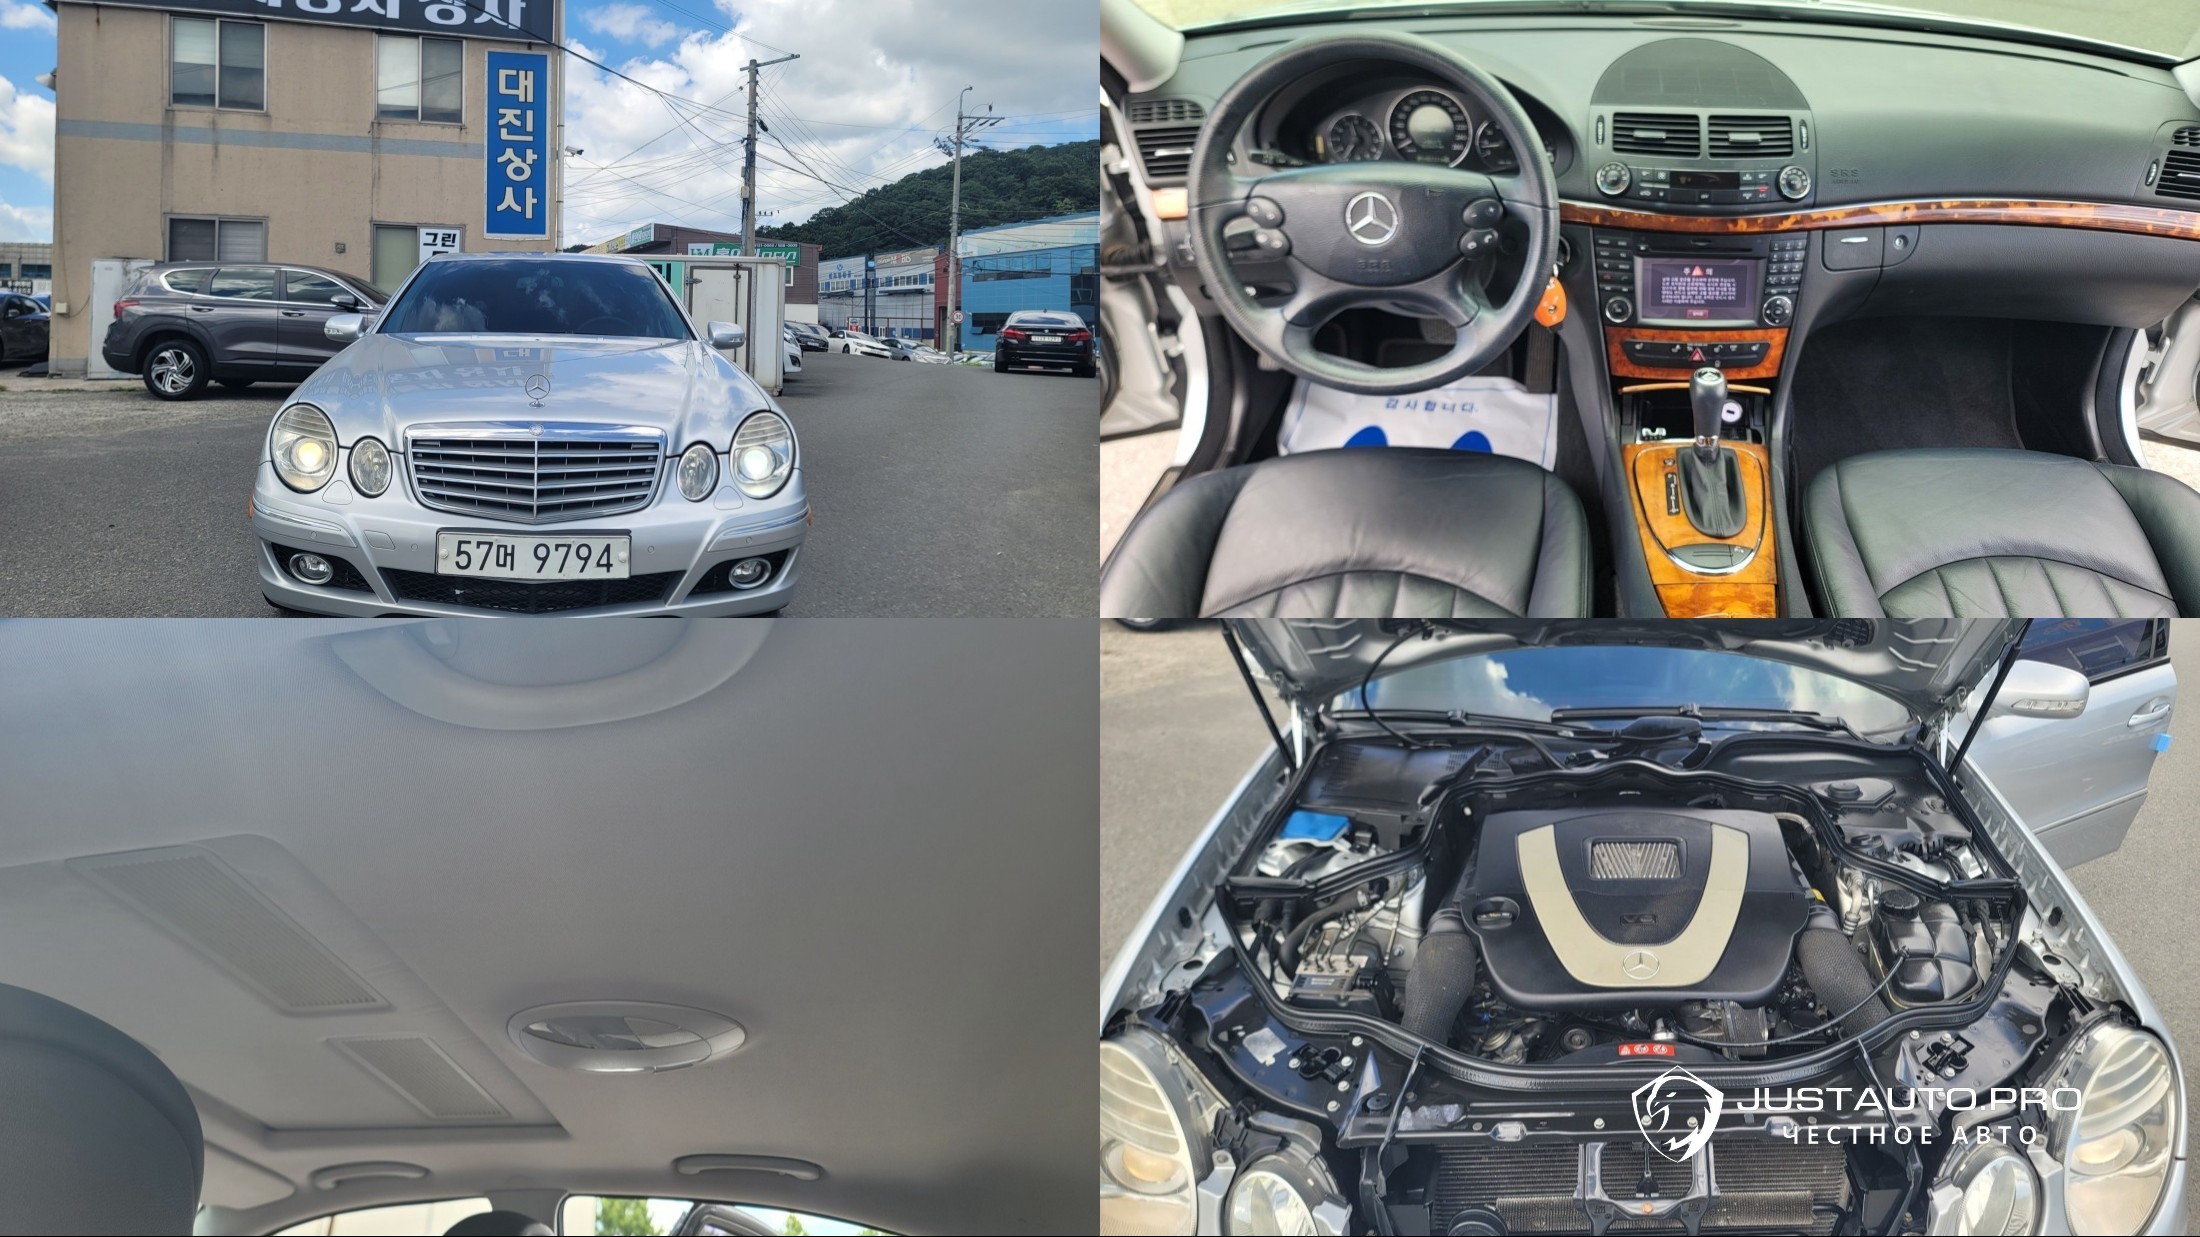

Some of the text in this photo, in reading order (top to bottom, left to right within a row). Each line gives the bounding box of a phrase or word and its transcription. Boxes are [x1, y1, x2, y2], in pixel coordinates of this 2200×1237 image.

[496, 68, 539, 220] 대진상사
[422, 232, 457, 248] 그린
[454, 540, 614, 573] 57머 9794
